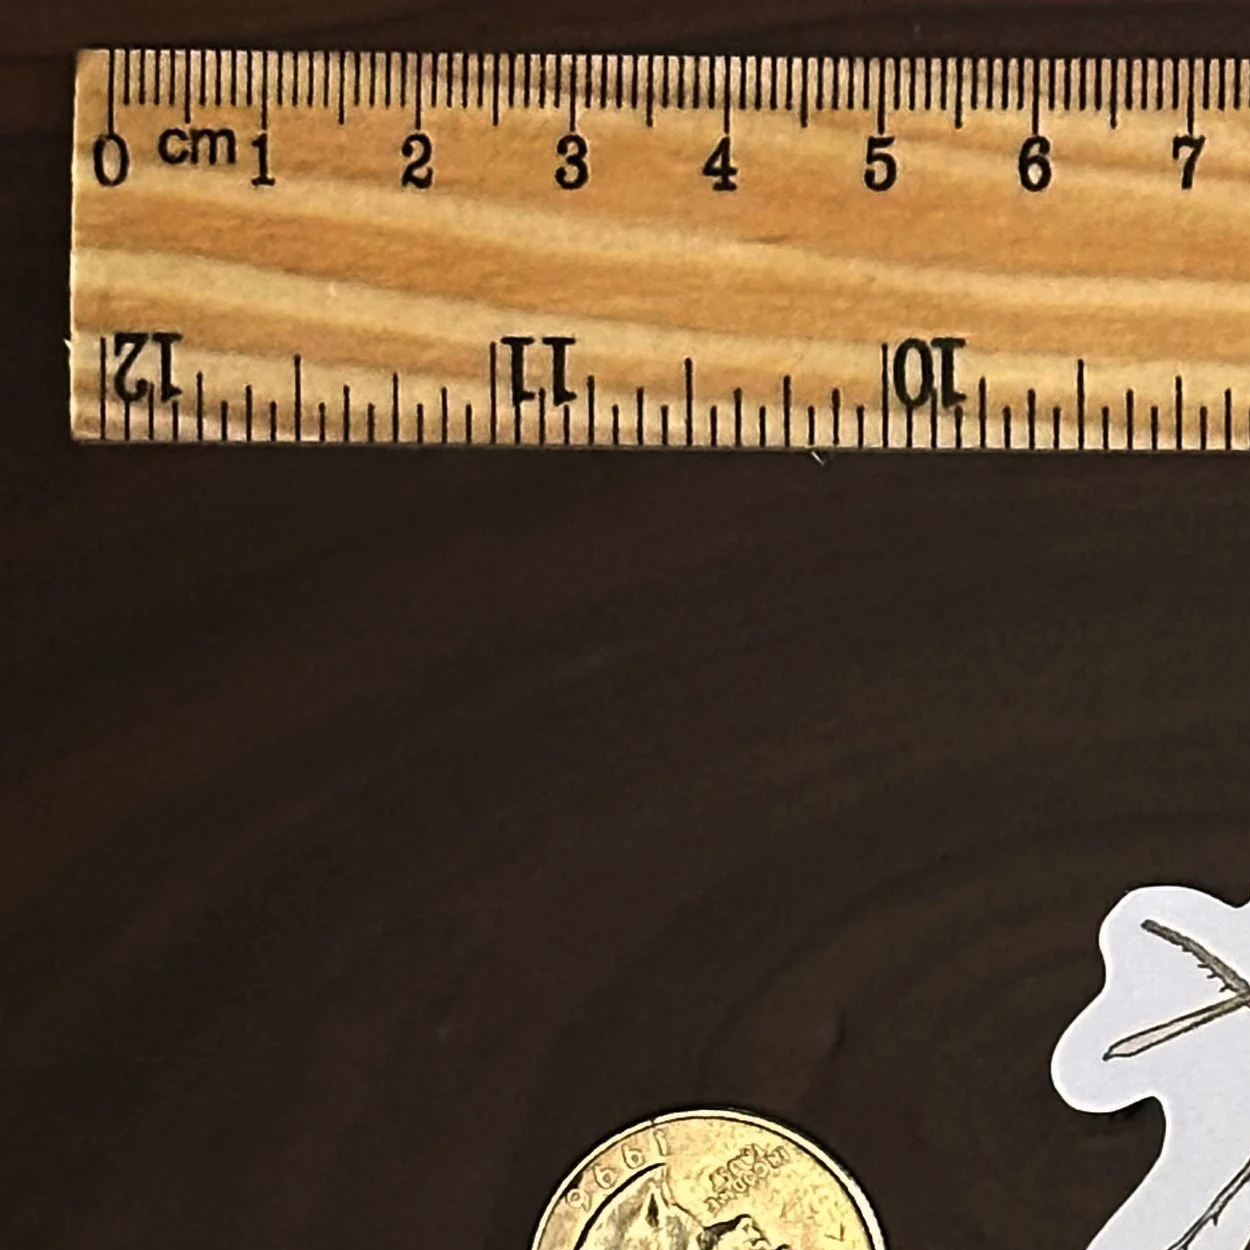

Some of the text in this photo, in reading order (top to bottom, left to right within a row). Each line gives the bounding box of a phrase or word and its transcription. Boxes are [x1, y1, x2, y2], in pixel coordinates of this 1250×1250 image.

[93, 133, 129, 186] 0
[158, 126, 236, 166] cm
[251, 133, 275, 187] 1
[401, 133, 434, 189] 2
[555, 134, 589, 191] 3
[703, 136, 738, 192] 4
[864, 136, 899, 192] 5
[1018, 136, 1052, 192] 6
[1172, 135, 1206, 191] 7
[113, 333, 183, 403] 12
[500, 336, 577, 406] 11
[893, 338, 967, 408] 10
[564, 1131, 673, 1212] 1996
